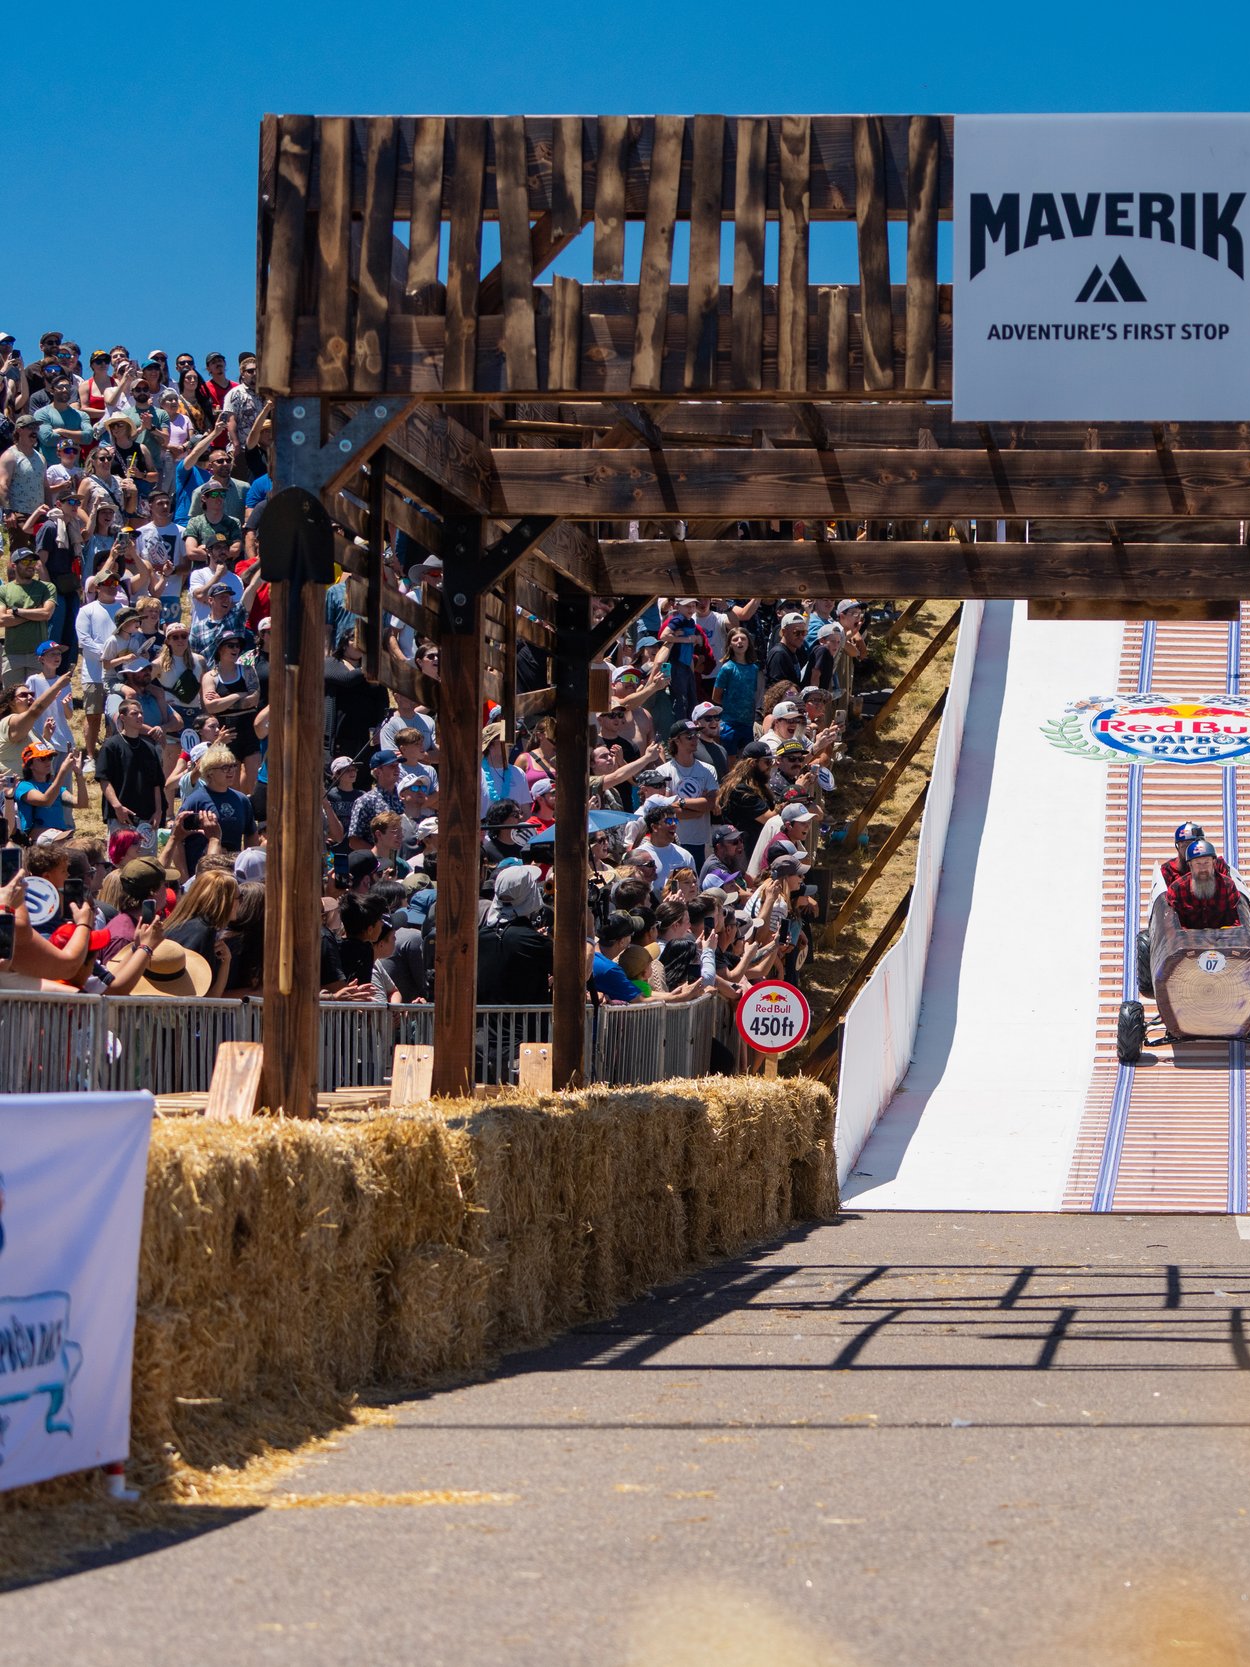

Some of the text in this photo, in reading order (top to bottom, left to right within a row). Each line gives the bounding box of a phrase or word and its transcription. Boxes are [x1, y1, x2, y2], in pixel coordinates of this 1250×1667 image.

[970, 192, 1247, 281] MAVERIK
[987, 323, 1230, 340] ADVENTURE'S FIRST STOP
[1100, 720, 1183, 733] Red
[185, 735, 196, 750] 10
[1152, 745, 1221, 756] RACE
[680, 782, 697, 798] 10
[1206, 960, 1219, 971] 07
[755, 1004, 791, 1013] Red Bull
